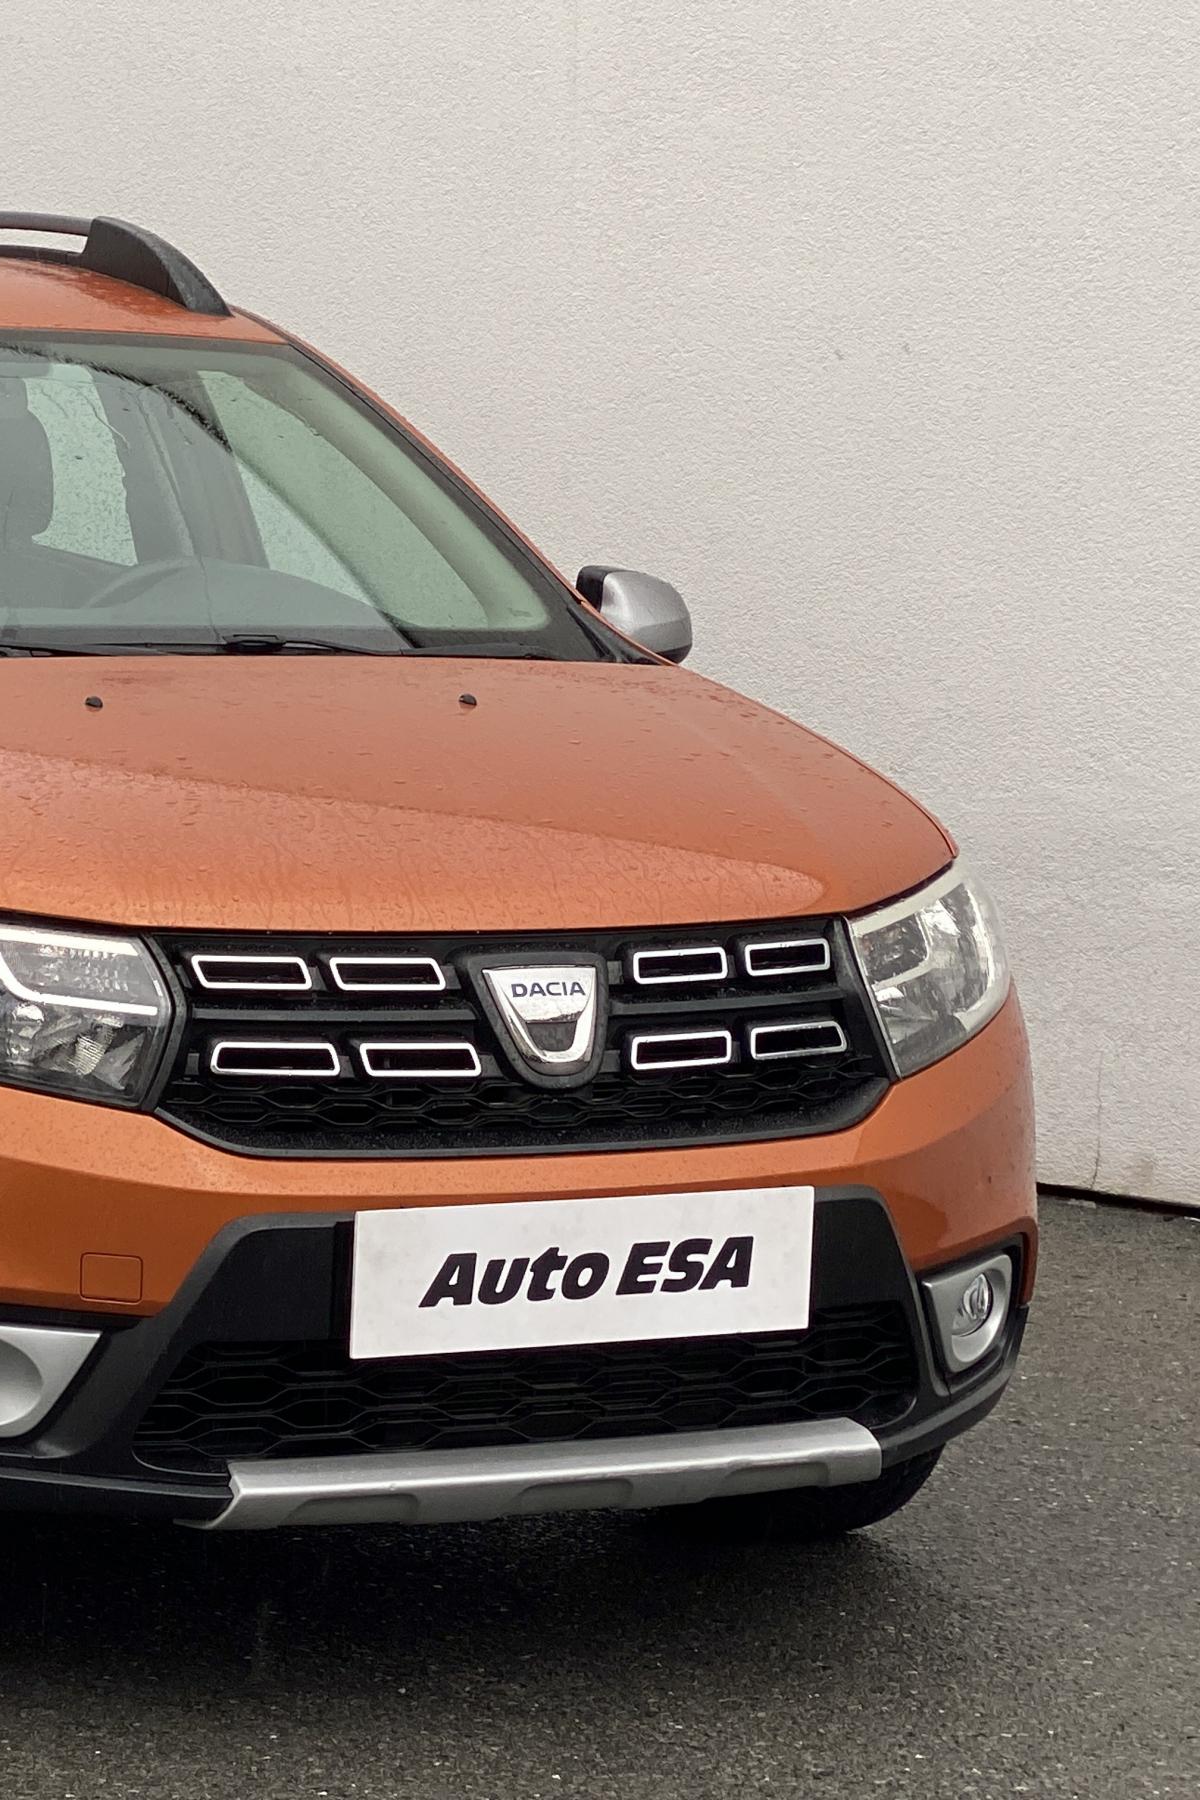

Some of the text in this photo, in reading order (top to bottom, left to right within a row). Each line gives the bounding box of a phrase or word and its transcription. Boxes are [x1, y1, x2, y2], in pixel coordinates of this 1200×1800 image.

[510, 981, 586, 998] DACIA
[418, 1236, 755, 1308] Auto ESA
